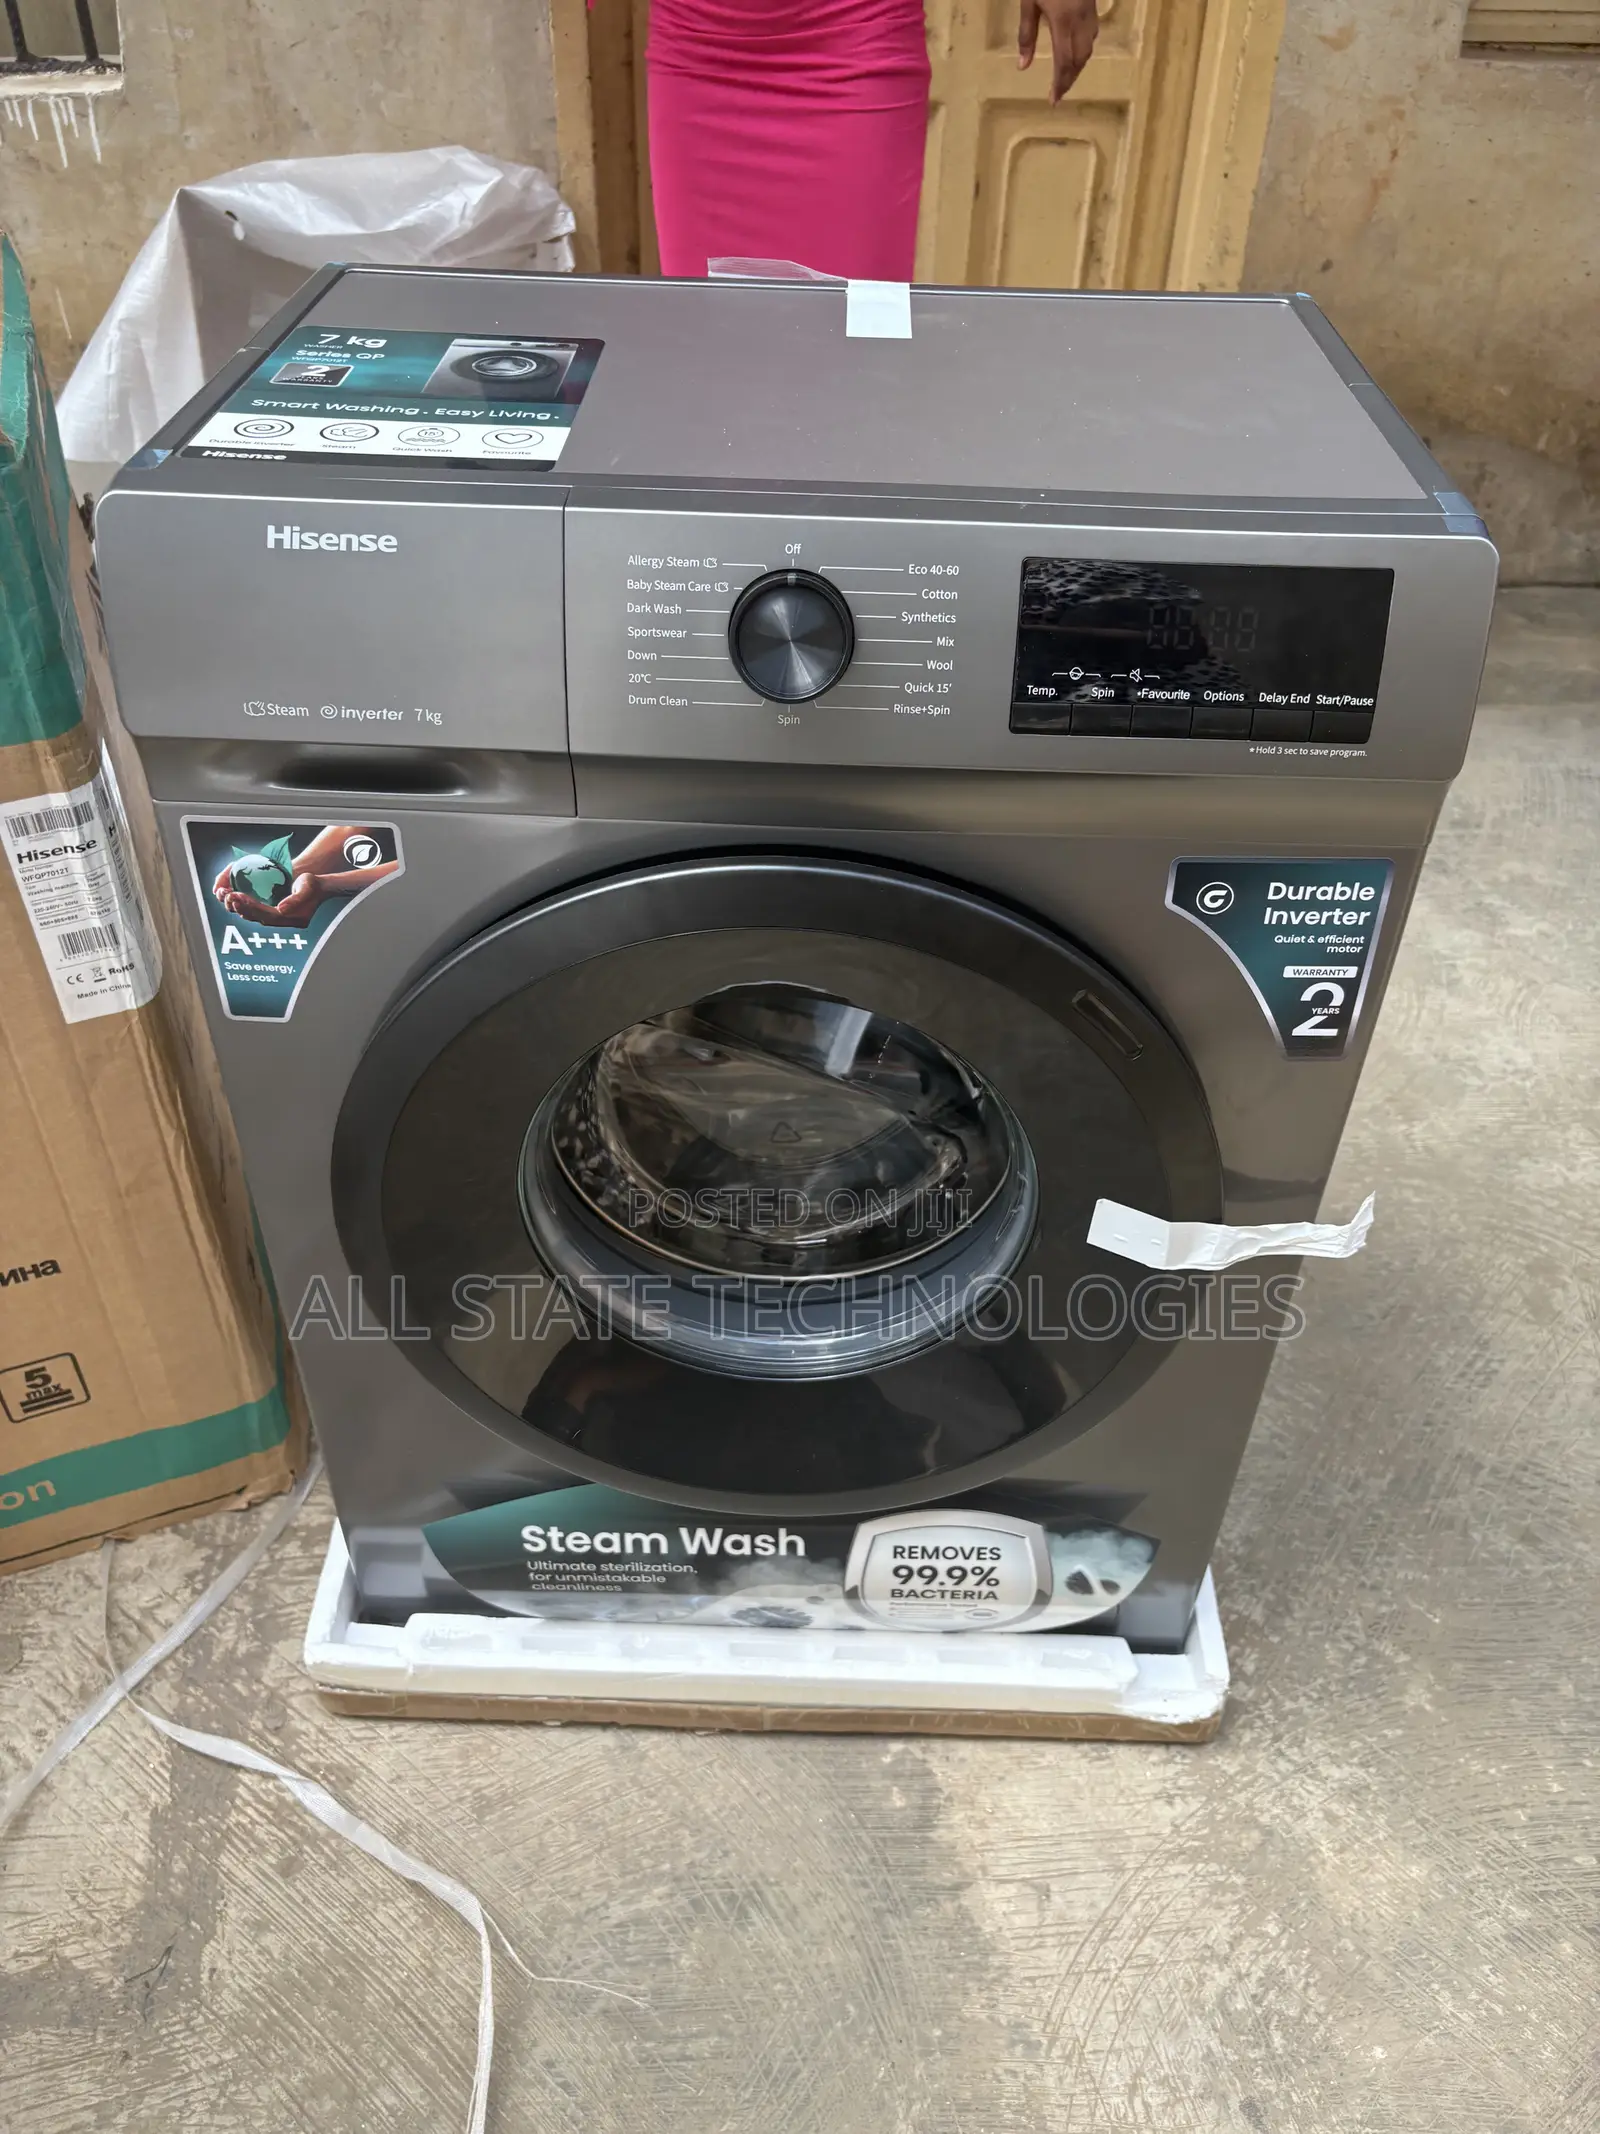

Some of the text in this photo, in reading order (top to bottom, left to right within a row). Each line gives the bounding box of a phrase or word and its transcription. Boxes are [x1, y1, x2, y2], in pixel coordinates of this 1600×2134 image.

[318, 334, 387, 349] 7 kg
[295, 349, 385, 360] Series QP
[301, 365, 330, 377] 2
[251, 399, 320, 410] Smart
[434, 408, 484, 418] Easy
[202, 449, 287, 460] Hisense
[266, 524, 398, 552] Hisense
[785, 543, 802, 554] Off
[627, 555, 700, 568] Allergy Steam
[908, 563, 959, 576] Eco 40-60
[627, 579, 711, 592] Baby Steam Care
[921, 588, 958, 600] Cotton
[627, 602, 682, 615] Dark Wash
[901, 611, 957, 625] Synthetics
[627, 626, 687, 639] Sportswear
[936, 636, 955, 647] Mix
[627, 649, 657, 661] Down
[927, 660, 953, 670] Wool
[904, 682, 934, 694] Quick
[1026, 685, 1058, 698] Temp.
[1091, 686, 1115, 699] Spin
[628, 694, 688, 707] Drum Clean
[1203, 690, 1245, 703] Options
[1258, 692, 1311, 706] Delay End
[1315, 694, 1374, 707] Start/Pause
[267, 703, 443, 725] Steam inverter 7 kg
[893, 703, 950, 717] Rinse+Spin
[777, 714, 800, 726] Spin
[1255, 745, 1368, 759] Hold 3 sec to save program.
[17, 840, 97, 864] Hisense
[1267, 882, 1375, 901] Durable
[1263, 907, 1371, 925] Inverter
[221, 925, 308, 956] A+++
[1274, 934, 1365, 944] Quiet & efficient
[1326, 945, 1363, 953] motor
[108, 962, 135, 976] RoHS
[224, 961, 296, 974] Save energy.
[1292, 968, 1349, 976] WARRANTY
[227, 972, 279, 983] Less cost.
[77, 989, 99, 999] Made
[109, 983, 132, 992] China
[1291, 981, 1345, 1037] 2
[1311, 1007, 1340, 1015] YEARS
[25, 1366, 53, 1390] 5
[25, 1383, 62, 1401] max
[520, 1525, 805, 1557] Steam Wash
[893, 1545, 1002, 1560] REMOVES
[526, 1560, 597, 1571] Ultimate
[529, 1572, 667, 1583] for unmistakable
[892, 1564, 1000, 1587] 99.9%
[531, 1582, 622, 1592] cleanliness
[890, 1588, 999, 1601] BACTERIA
